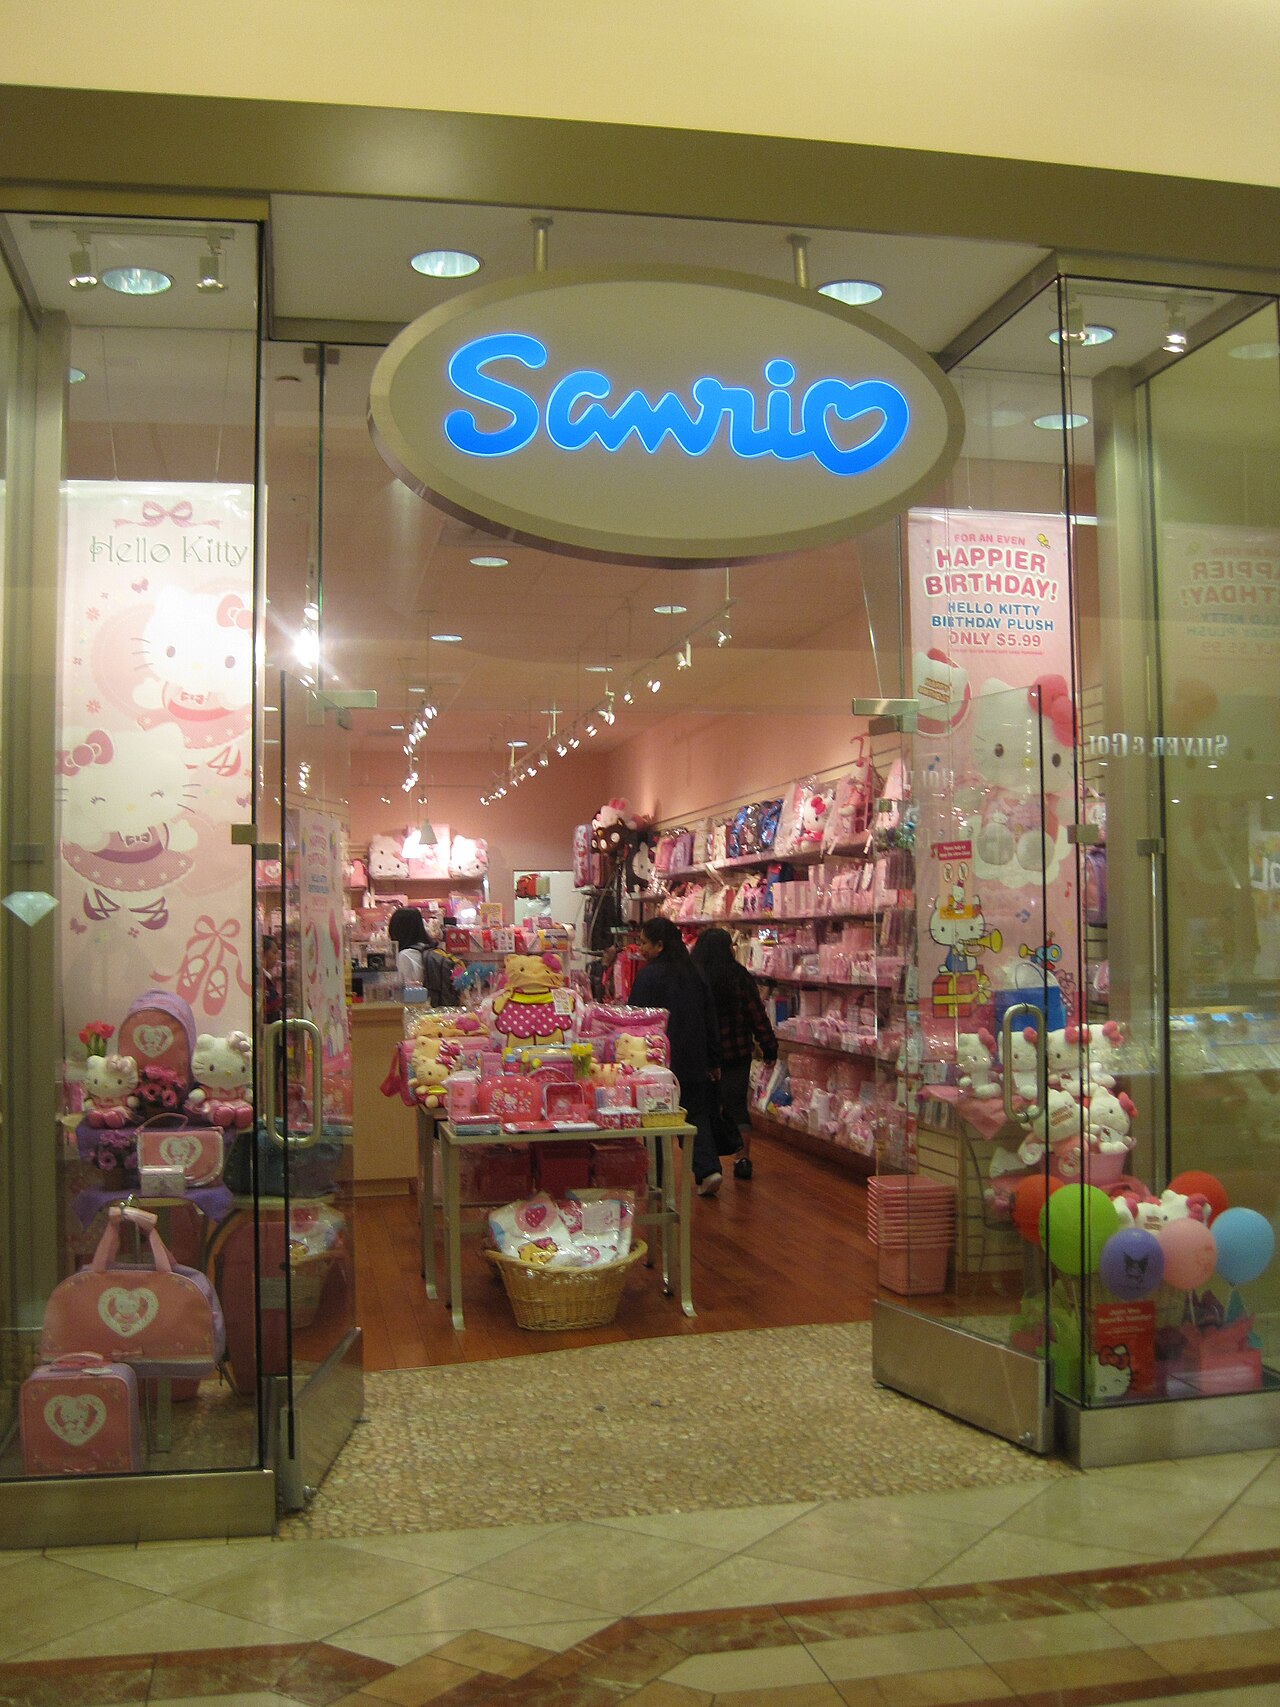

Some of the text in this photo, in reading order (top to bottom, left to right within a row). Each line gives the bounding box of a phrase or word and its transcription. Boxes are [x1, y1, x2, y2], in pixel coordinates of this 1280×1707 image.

[444, 332, 910, 476] Sanrio
[89, 535, 248, 567] Hello Kitty
[954, 534, 1025, 546] FOR AN EVEN
[936, 547, 1046, 574] HAPPIER
[925, 572, 1057, 601] BIRTHDAY!
[948, 602, 1040, 616] HELLO KITTY
[931, 616, 1054, 630] BIRTHDAY PLUSH
[949, 631, 1041, 648] ONLY $5.99
